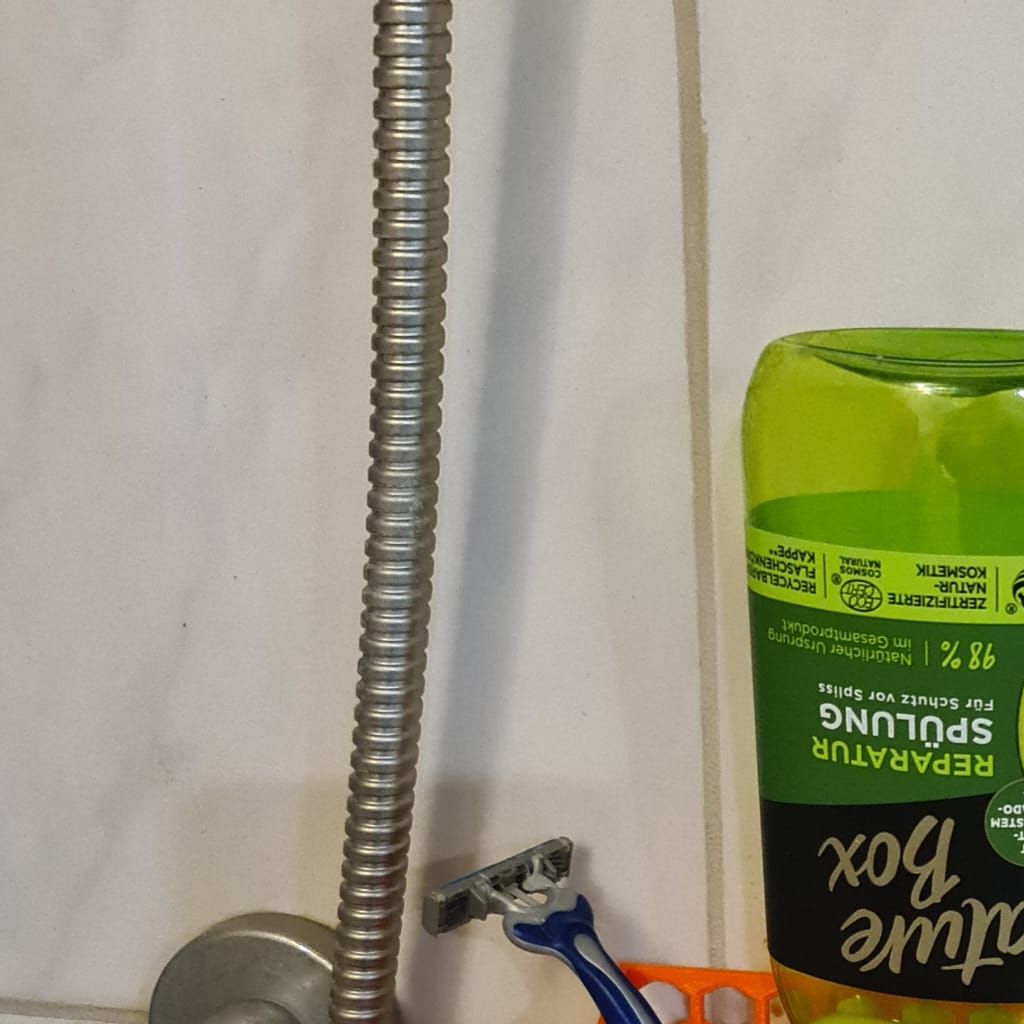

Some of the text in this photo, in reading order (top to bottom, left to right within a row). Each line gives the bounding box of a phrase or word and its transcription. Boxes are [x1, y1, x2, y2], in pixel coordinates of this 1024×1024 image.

[839, 556, 882, 570] NATURAL
[840, 565, 882, 579] COSMOS
[915, 564, 987, 580] KOSMETIK
[888, 592, 987, 610] ZERTIFIZIERTE
[934, 581, 987, 595] NATUR-
[768, 628, 912, 666] Natürlicher Ursprung
[781, 619, 912, 651] im Gesamtprodukt
[818, 683, 994, 711] Für Schutz vor Spliss
[819, 703, 993, 748] SPÜLUNG
[811, 736, 994, 777] REPARATUR
[818, 815, 961, 910] Box
